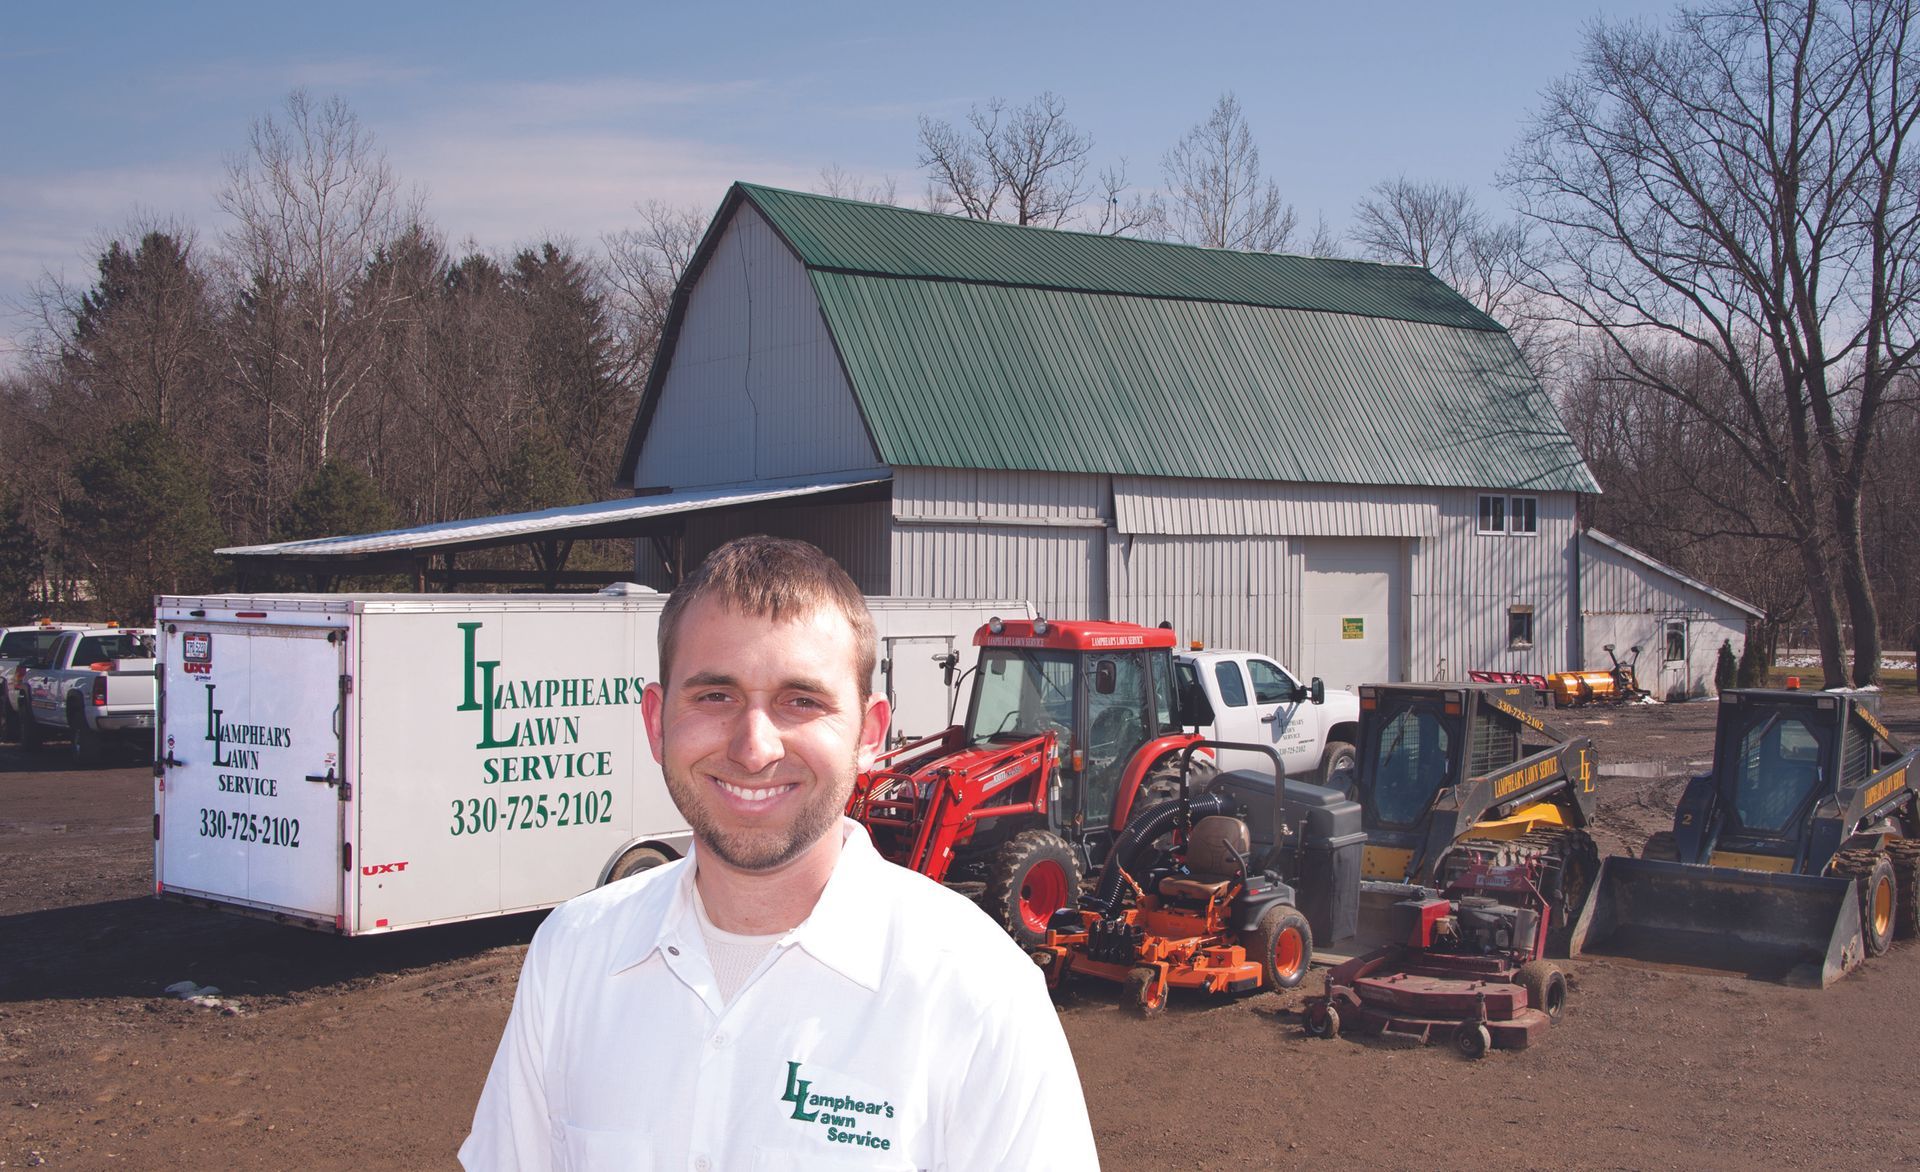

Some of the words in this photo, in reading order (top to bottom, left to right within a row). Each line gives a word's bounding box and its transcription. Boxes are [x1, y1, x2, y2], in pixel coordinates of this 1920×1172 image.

[184, 662, 212, 674] UXT
[205, 684, 291, 748] LAMPHEAR'S
[476, 661, 581, 750] LAWN
[1497, 699, 1545, 731] 330-725-2102
[213, 710, 260, 770] LAWN
[218, 774, 278, 797] SERVICE
[483, 751, 613, 784] SERVICE
[200, 808, 300, 848] 330-725-2102
[450, 790, 613, 836] 330-725-2102
[363, 862, 409, 875] UXT
[780, 1060, 895, 1119] Lamphear's
[790, 1079, 856, 1128] Lawn
[827, 1126, 891, 1151] Service
